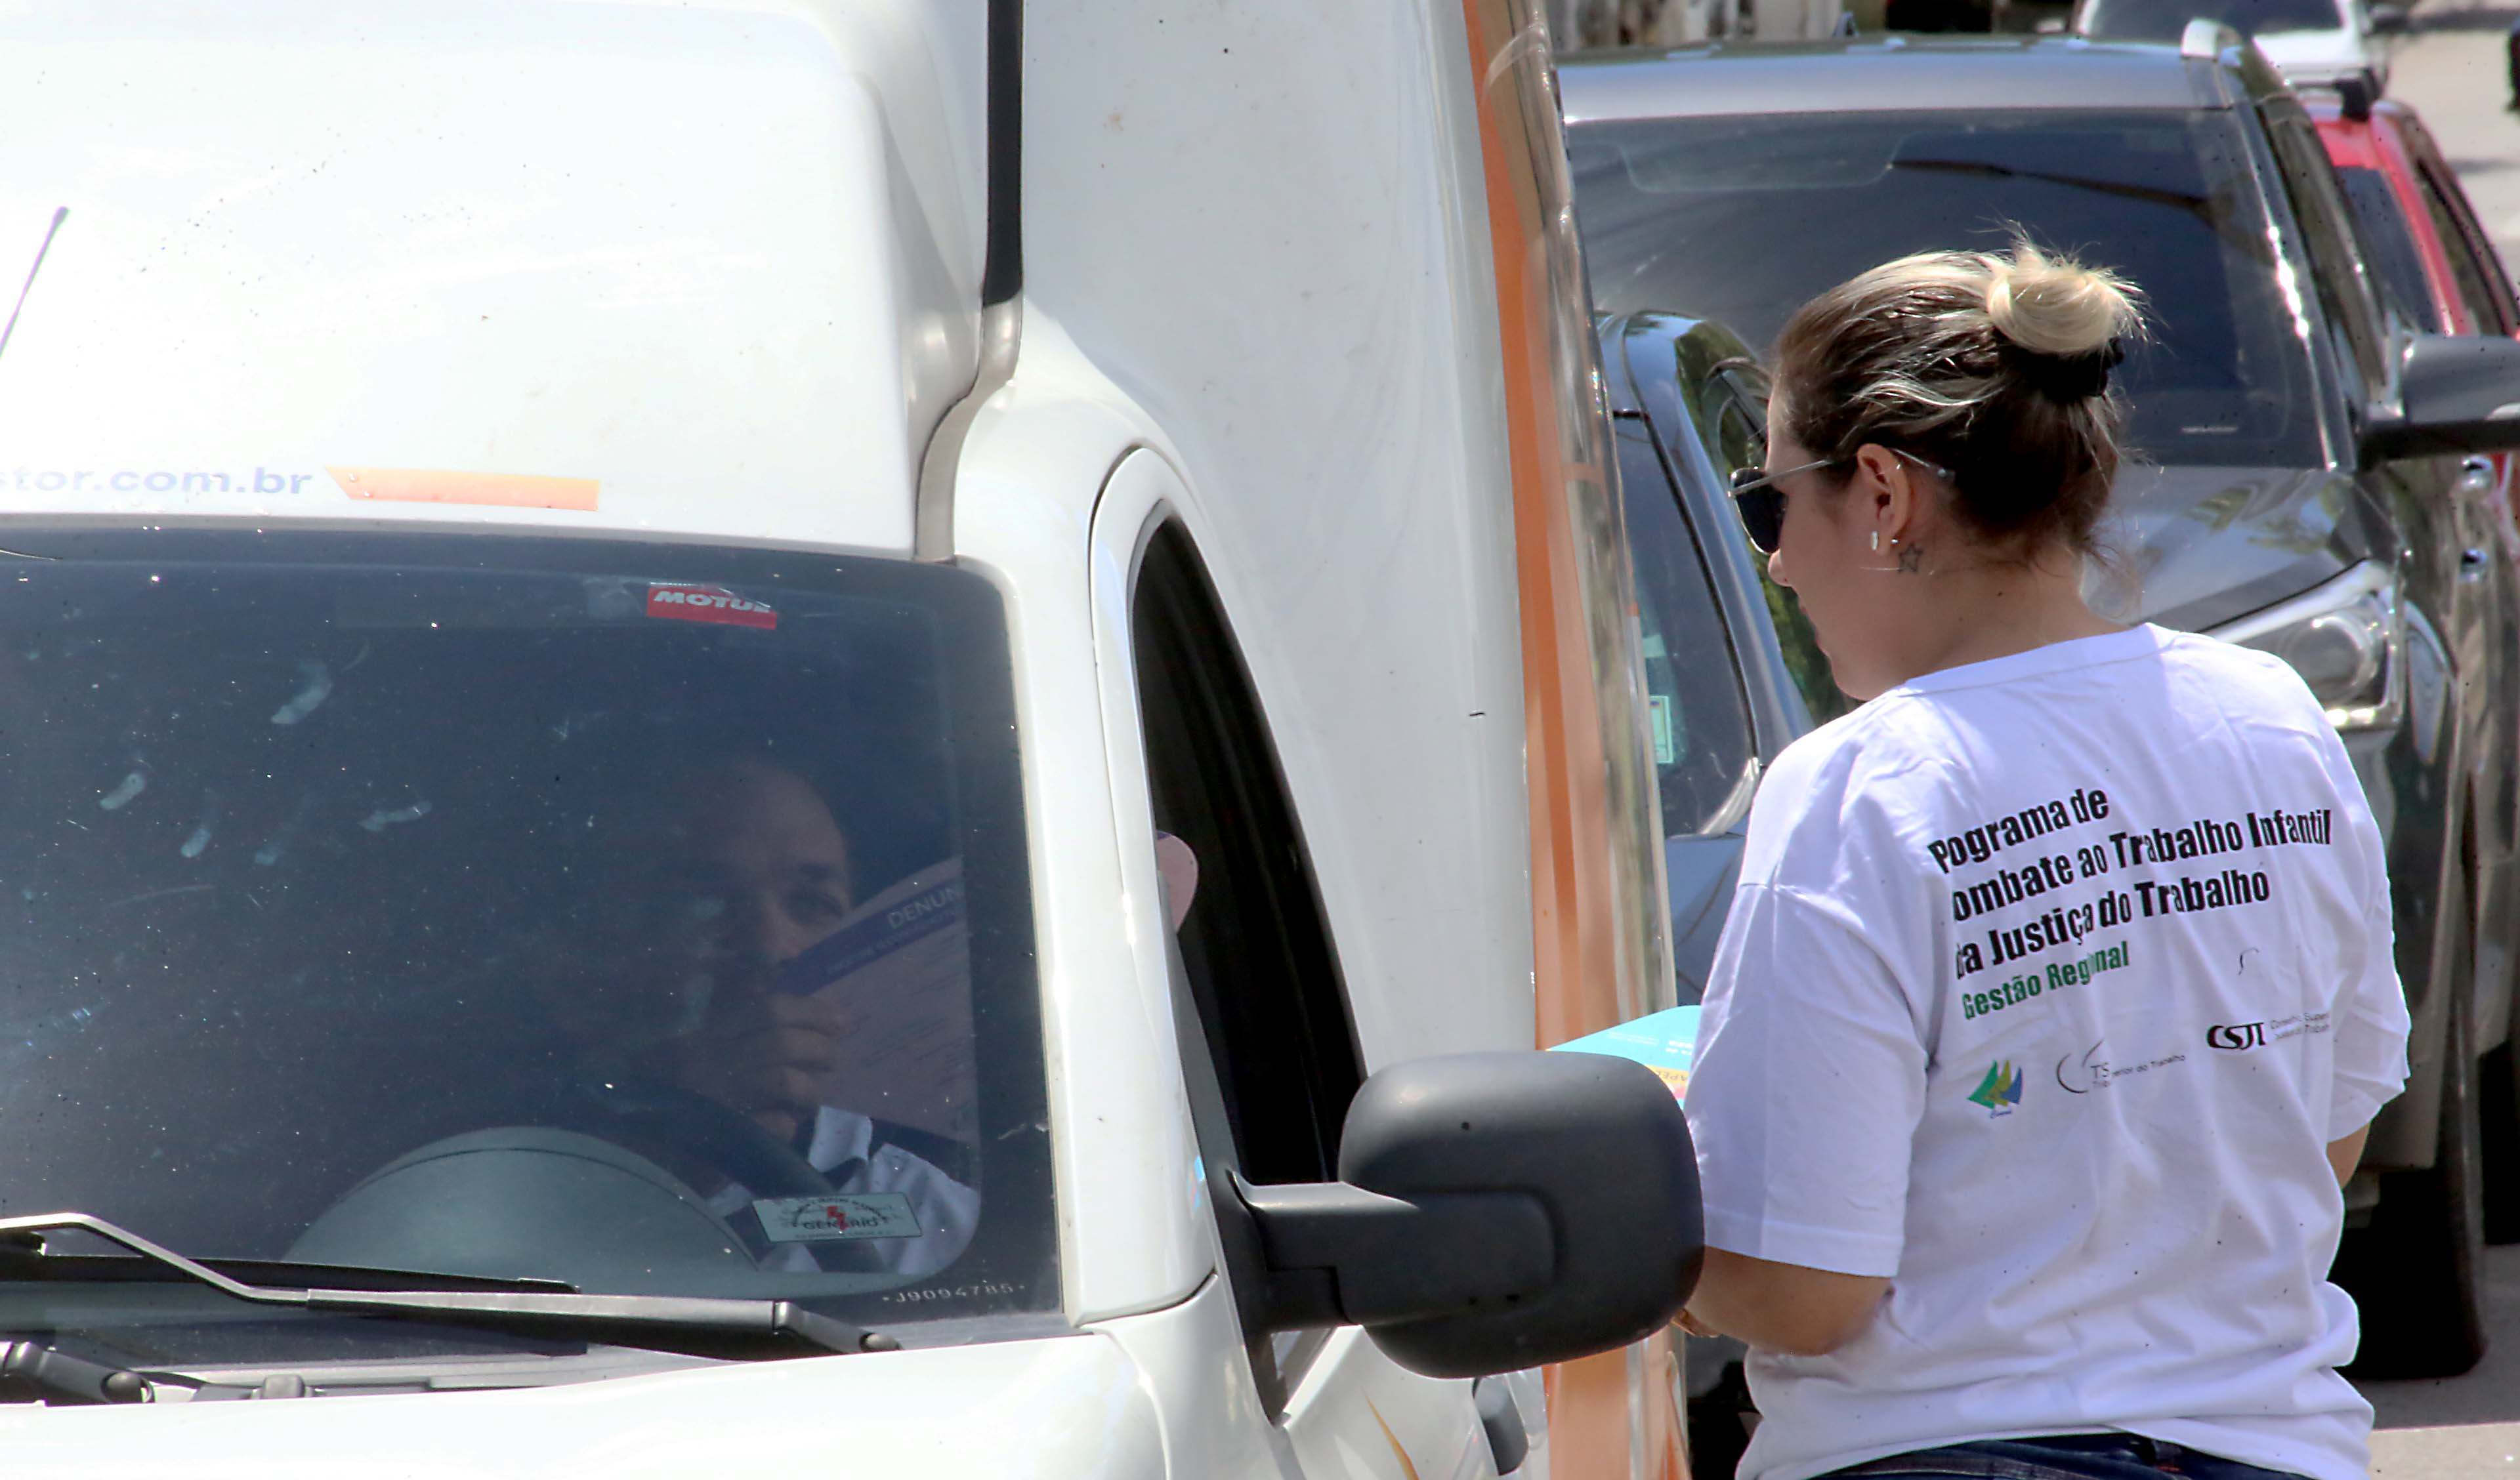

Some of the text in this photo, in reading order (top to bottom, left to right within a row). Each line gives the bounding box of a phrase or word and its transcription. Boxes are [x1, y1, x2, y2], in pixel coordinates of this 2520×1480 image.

[0, 466, 313, 494] tor.com.br
[2070, 788, 2110, 824] de
[2077, 844, 2109, 878] ao
[2109, 819, 2244, 869] Trabalho
[2246, 809, 2332, 848] Infantil
[1987, 903, 2095, 947] Justiça
[2099, 890, 2133, 928] do
[2134, 869, 2271, 918] Trabalho
[1962, 940, 2130, 1020] Gestão Regnal
[2207, 1021, 2266, 1050] CSJT
